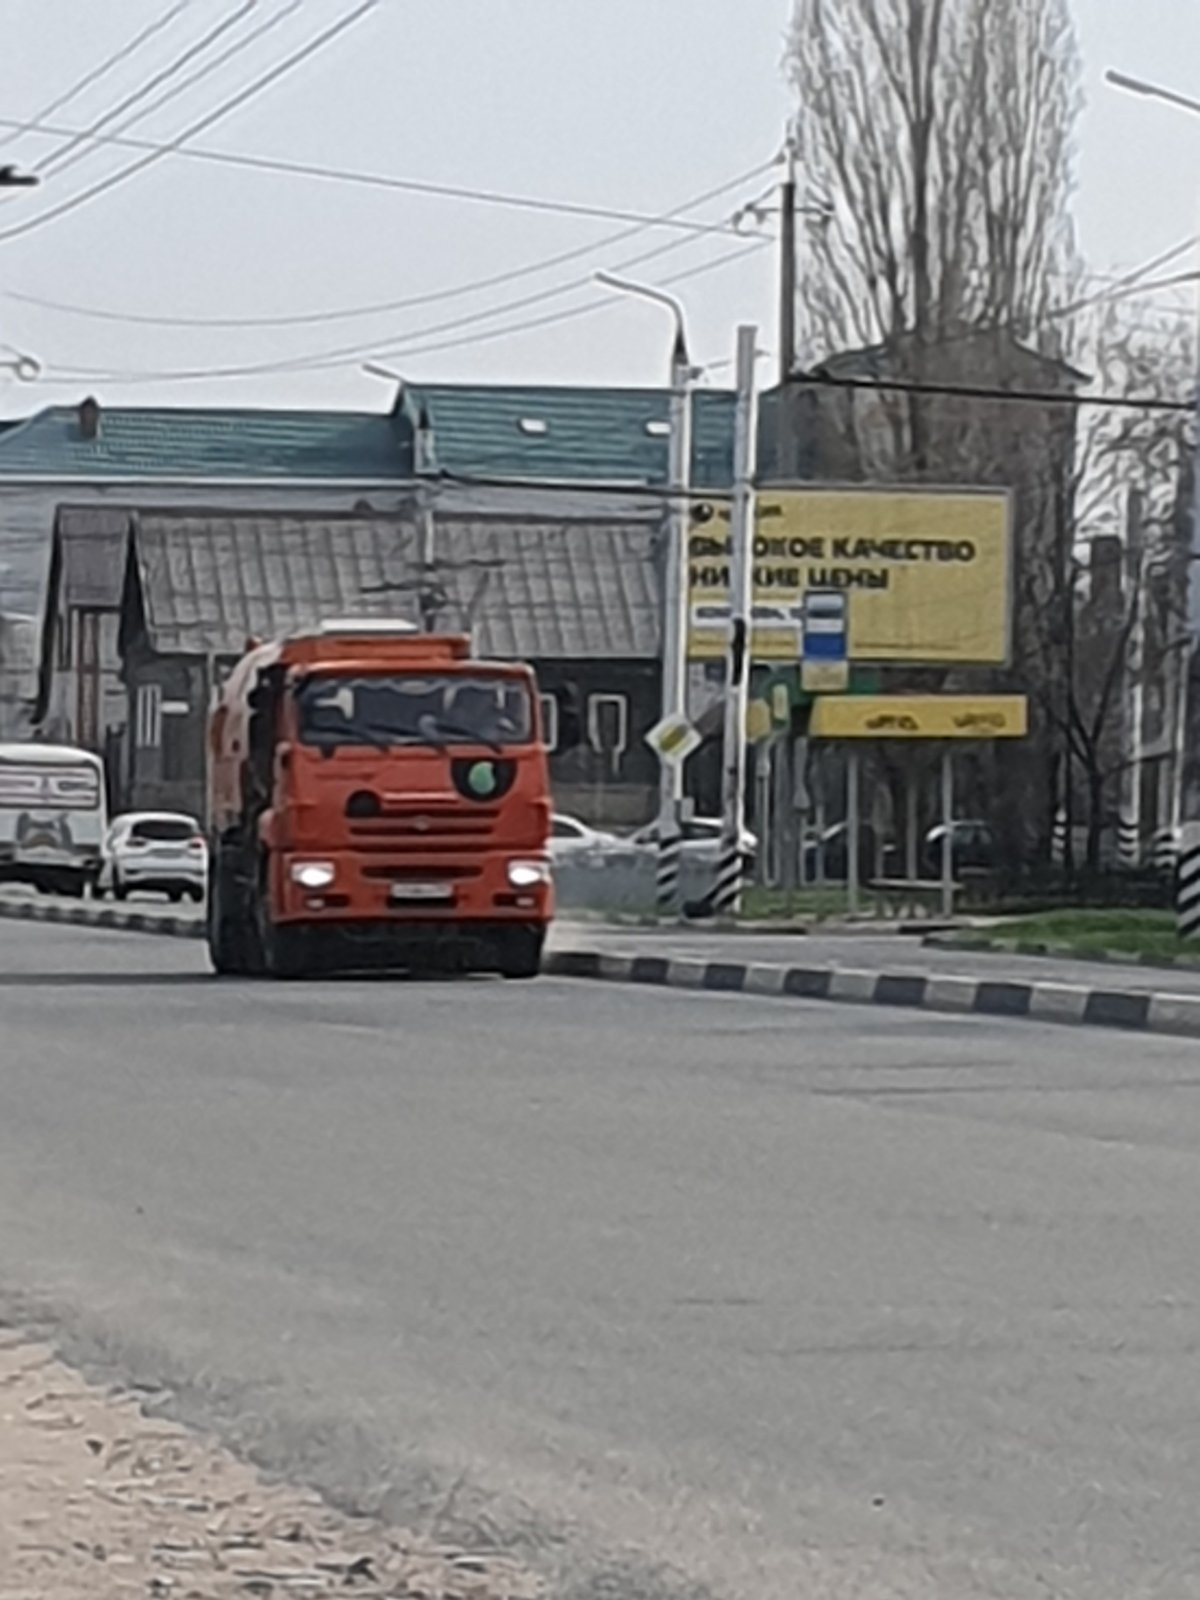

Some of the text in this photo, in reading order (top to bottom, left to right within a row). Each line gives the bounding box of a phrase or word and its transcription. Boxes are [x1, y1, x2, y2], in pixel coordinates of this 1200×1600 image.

[688, 536, 976, 562] ВЫОКОЕ КАЧЕСТВО
[688, 566, 889, 589] НИКИЕ ЦЕНЫ
